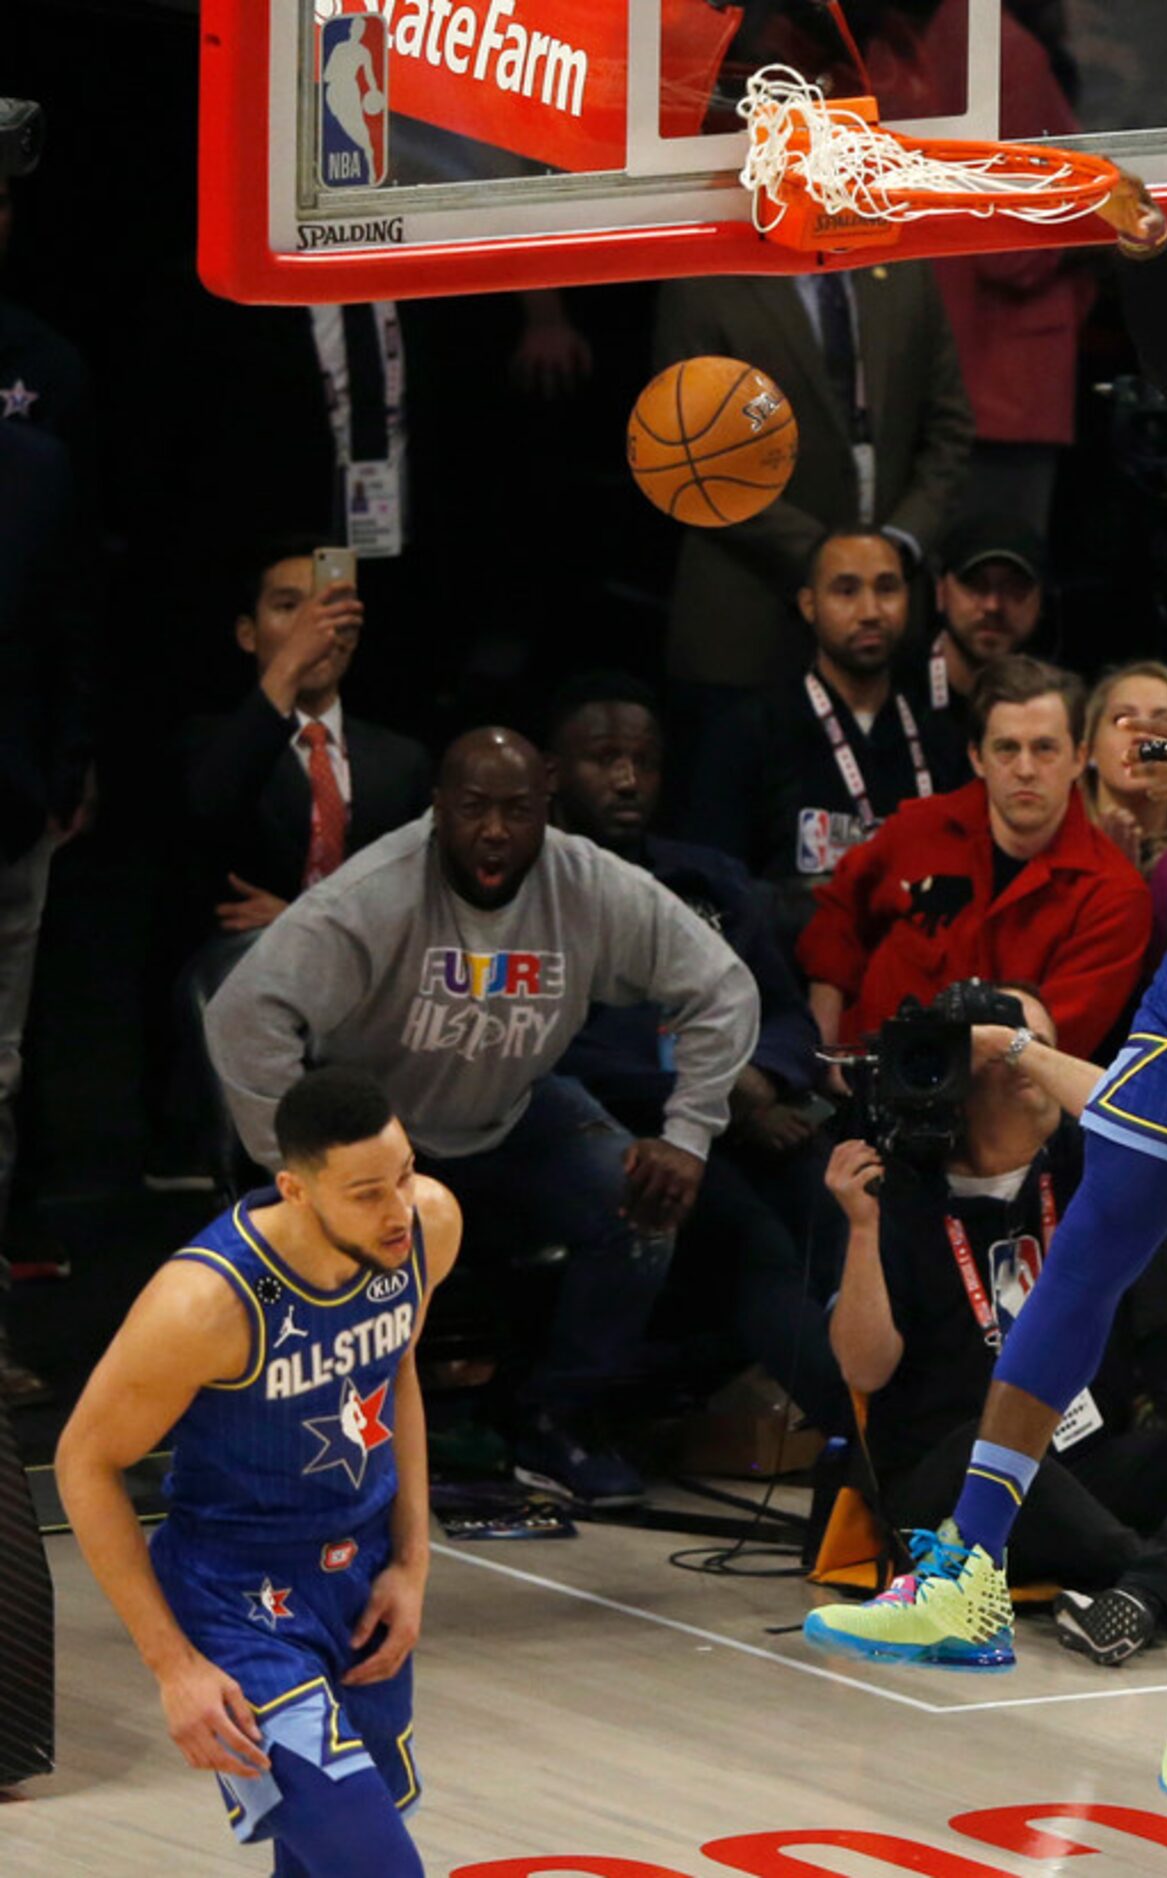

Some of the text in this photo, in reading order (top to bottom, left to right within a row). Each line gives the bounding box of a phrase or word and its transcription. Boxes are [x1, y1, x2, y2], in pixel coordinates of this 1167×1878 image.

[327, 151, 361, 180] NBA
[296, 217, 404, 251] SPALDING
[419, 946, 565, 1000] FUTURE
[400, 997, 561, 1061] HISTORY
[373, 1275, 402, 1299] KIA
[266, 1302, 414, 1401] ALL-STAR
